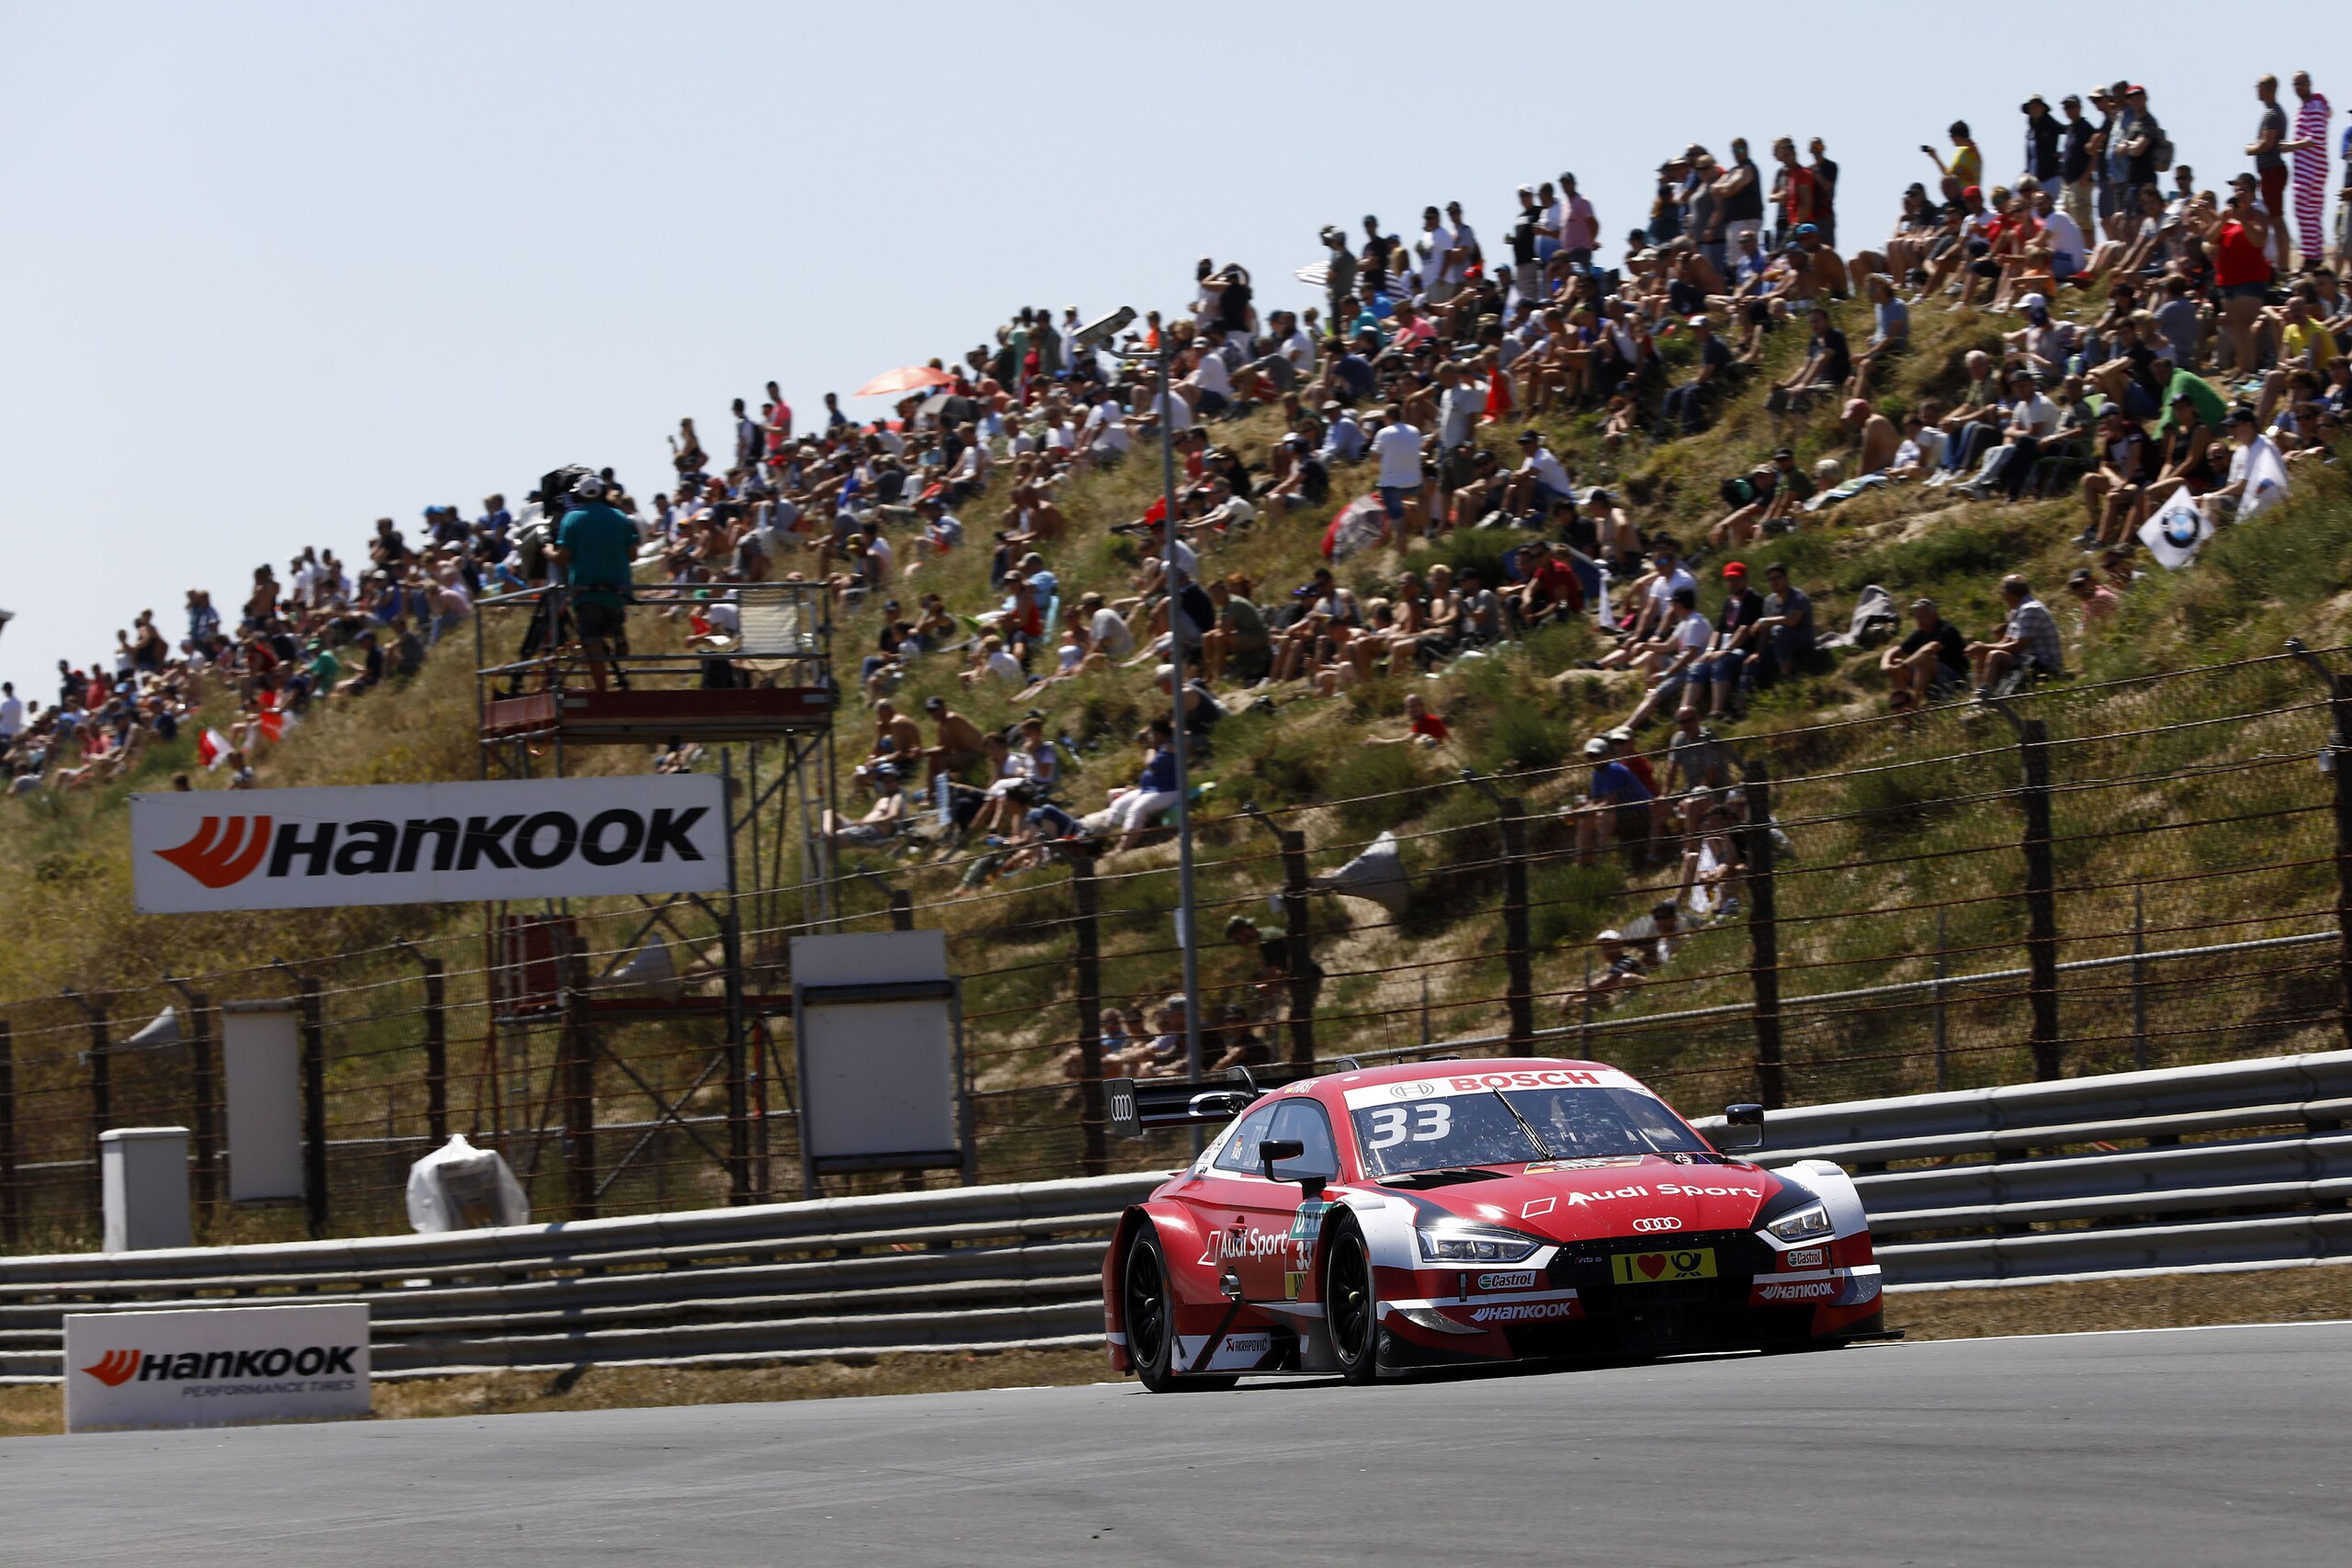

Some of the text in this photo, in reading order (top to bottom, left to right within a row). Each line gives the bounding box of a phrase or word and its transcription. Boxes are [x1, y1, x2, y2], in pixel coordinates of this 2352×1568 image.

[1449, 1072, 1600, 1092] BOSCH
[1369, 1103, 1451, 1150] 33
[1567, 1183, 1762, 1206] Audi Sport
[1221, 1228, 1287, 1263] Audi Sport
[1296, 1241, 1312, 1270] 33
[1797, 1251, 1821, 1264] Castrol
[1492, 1273, 1532, 1287] Castrol
[183, 1380, 356, 1398] PERFORMANCE TIRES
